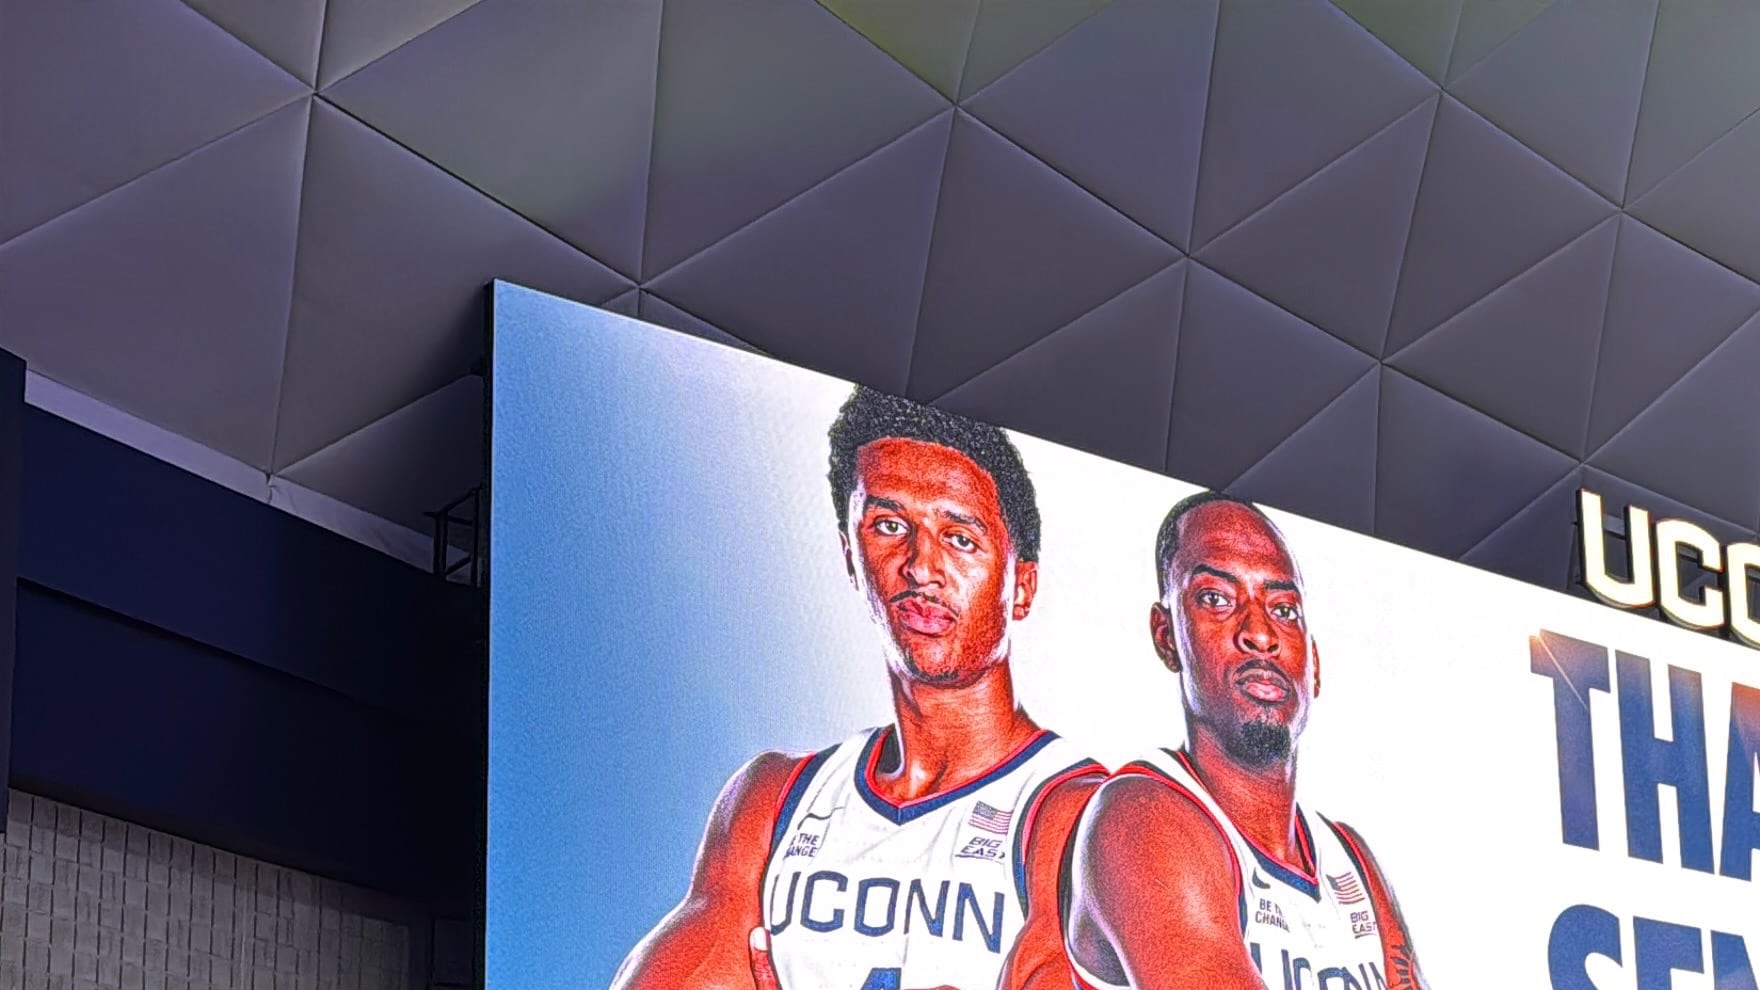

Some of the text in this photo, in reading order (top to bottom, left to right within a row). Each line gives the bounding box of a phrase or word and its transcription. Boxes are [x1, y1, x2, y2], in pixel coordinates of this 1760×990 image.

[968, 836, 1004, 849] BIG
[1259, 898, 1272, 910] BE
[770, 870, 1004, 953] UCONN
[1350, 911, 1370, 925] BIG
